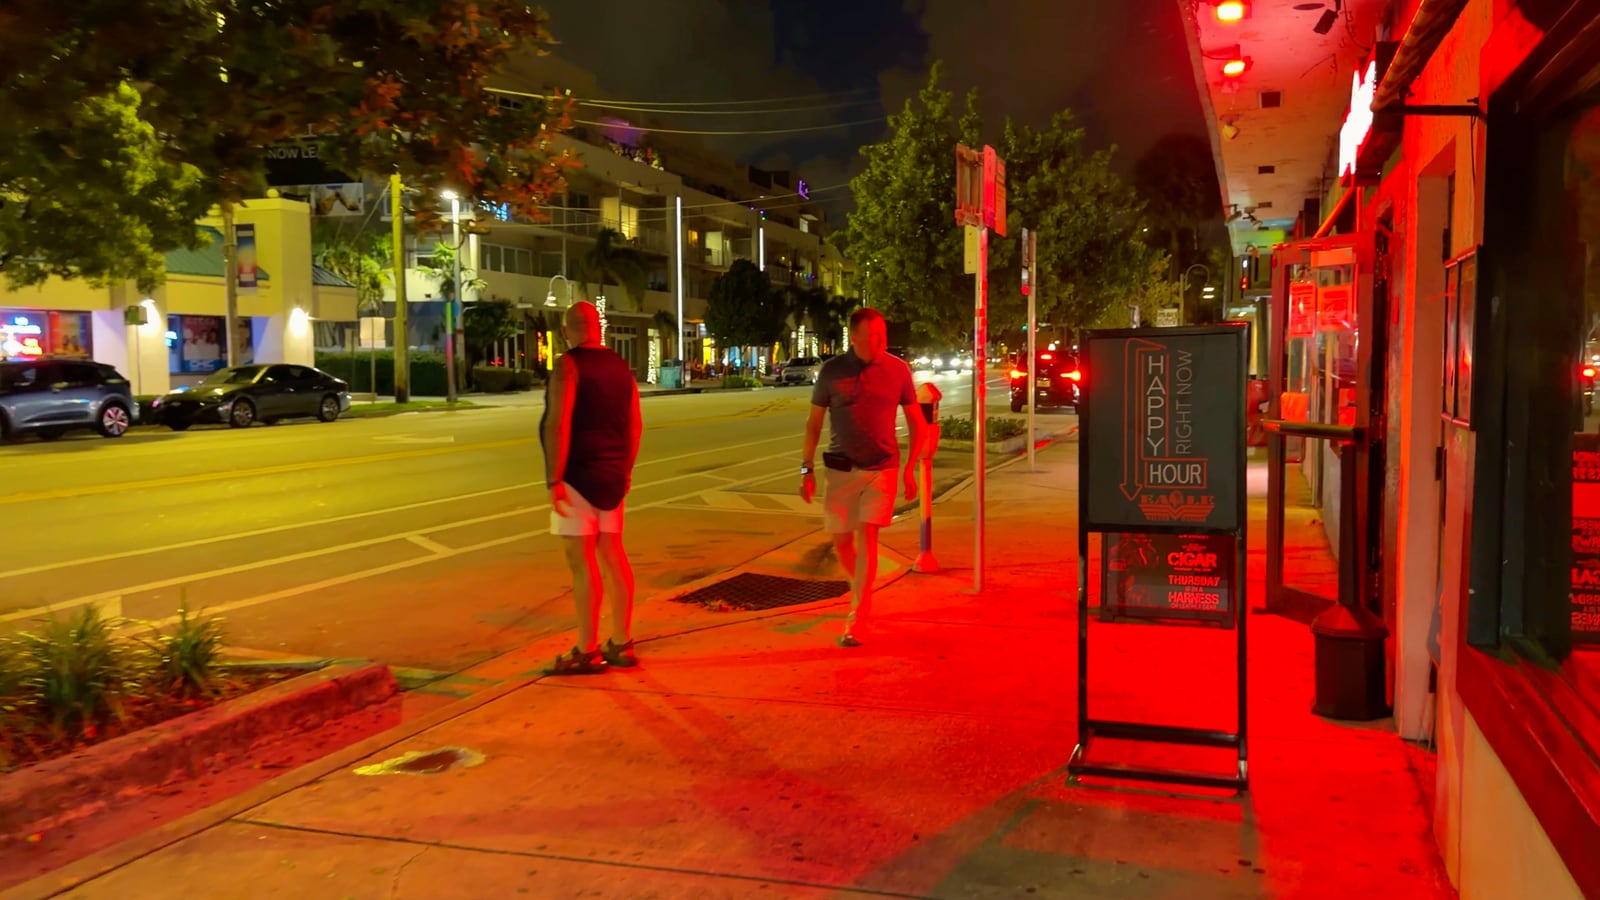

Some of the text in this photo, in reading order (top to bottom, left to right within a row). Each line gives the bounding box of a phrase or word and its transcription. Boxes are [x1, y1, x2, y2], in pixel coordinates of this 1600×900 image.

[268, 146, 320, 160] NOW LE
[1146, 355, 1166, 457] HAPPY
[1175, 349, 1193, 455] RIGHT NOW
[1150, 463, 1202, 485] HOUR
[1167, 552, 1217, 568] CIGAR
[1167, 574, 1220, 587] THURSDAY
[1167, 592, 1220, 604] HARNESS
